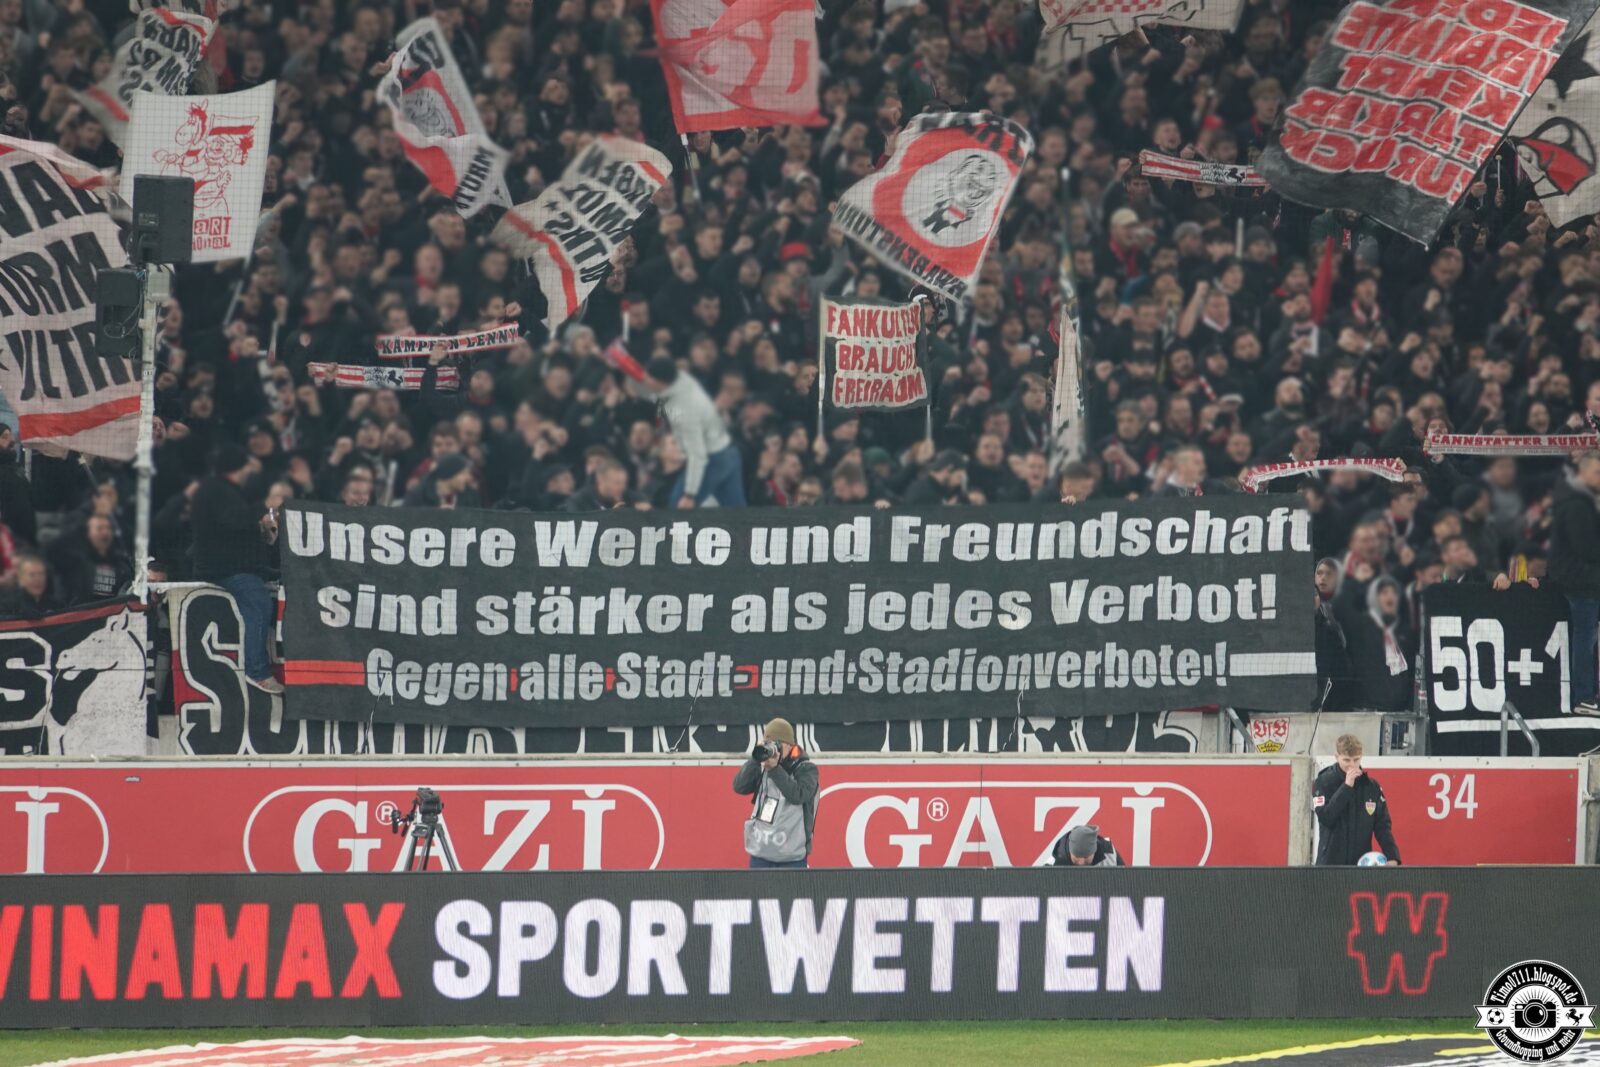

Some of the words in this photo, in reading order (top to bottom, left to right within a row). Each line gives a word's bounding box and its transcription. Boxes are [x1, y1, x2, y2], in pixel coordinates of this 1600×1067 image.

[834, 371, 924, 405] FREIRAUM
[285, 509, 516, 568] Unsere
[534, 519, 731, 568] Werte
[750, 516, 871, 565] und
[889, 507, 1311, 563] Freundschaft
[475, 585, 714, 636] stärker
[731, 585, 828, 633] als
[844, 582, 1033, 635] jedes
[1049, 573, 1277, 626] Verbot!
[366, 648, 507, 706] Gegen
[519, 653, 604, 701] alle
[761, 650, 846, 696] und
[1430, 614, 1571, 713] 50+1
[1427, 773, 1479, 820] 34
[432, 896, 1166, 1000] SPORTWETTEN
